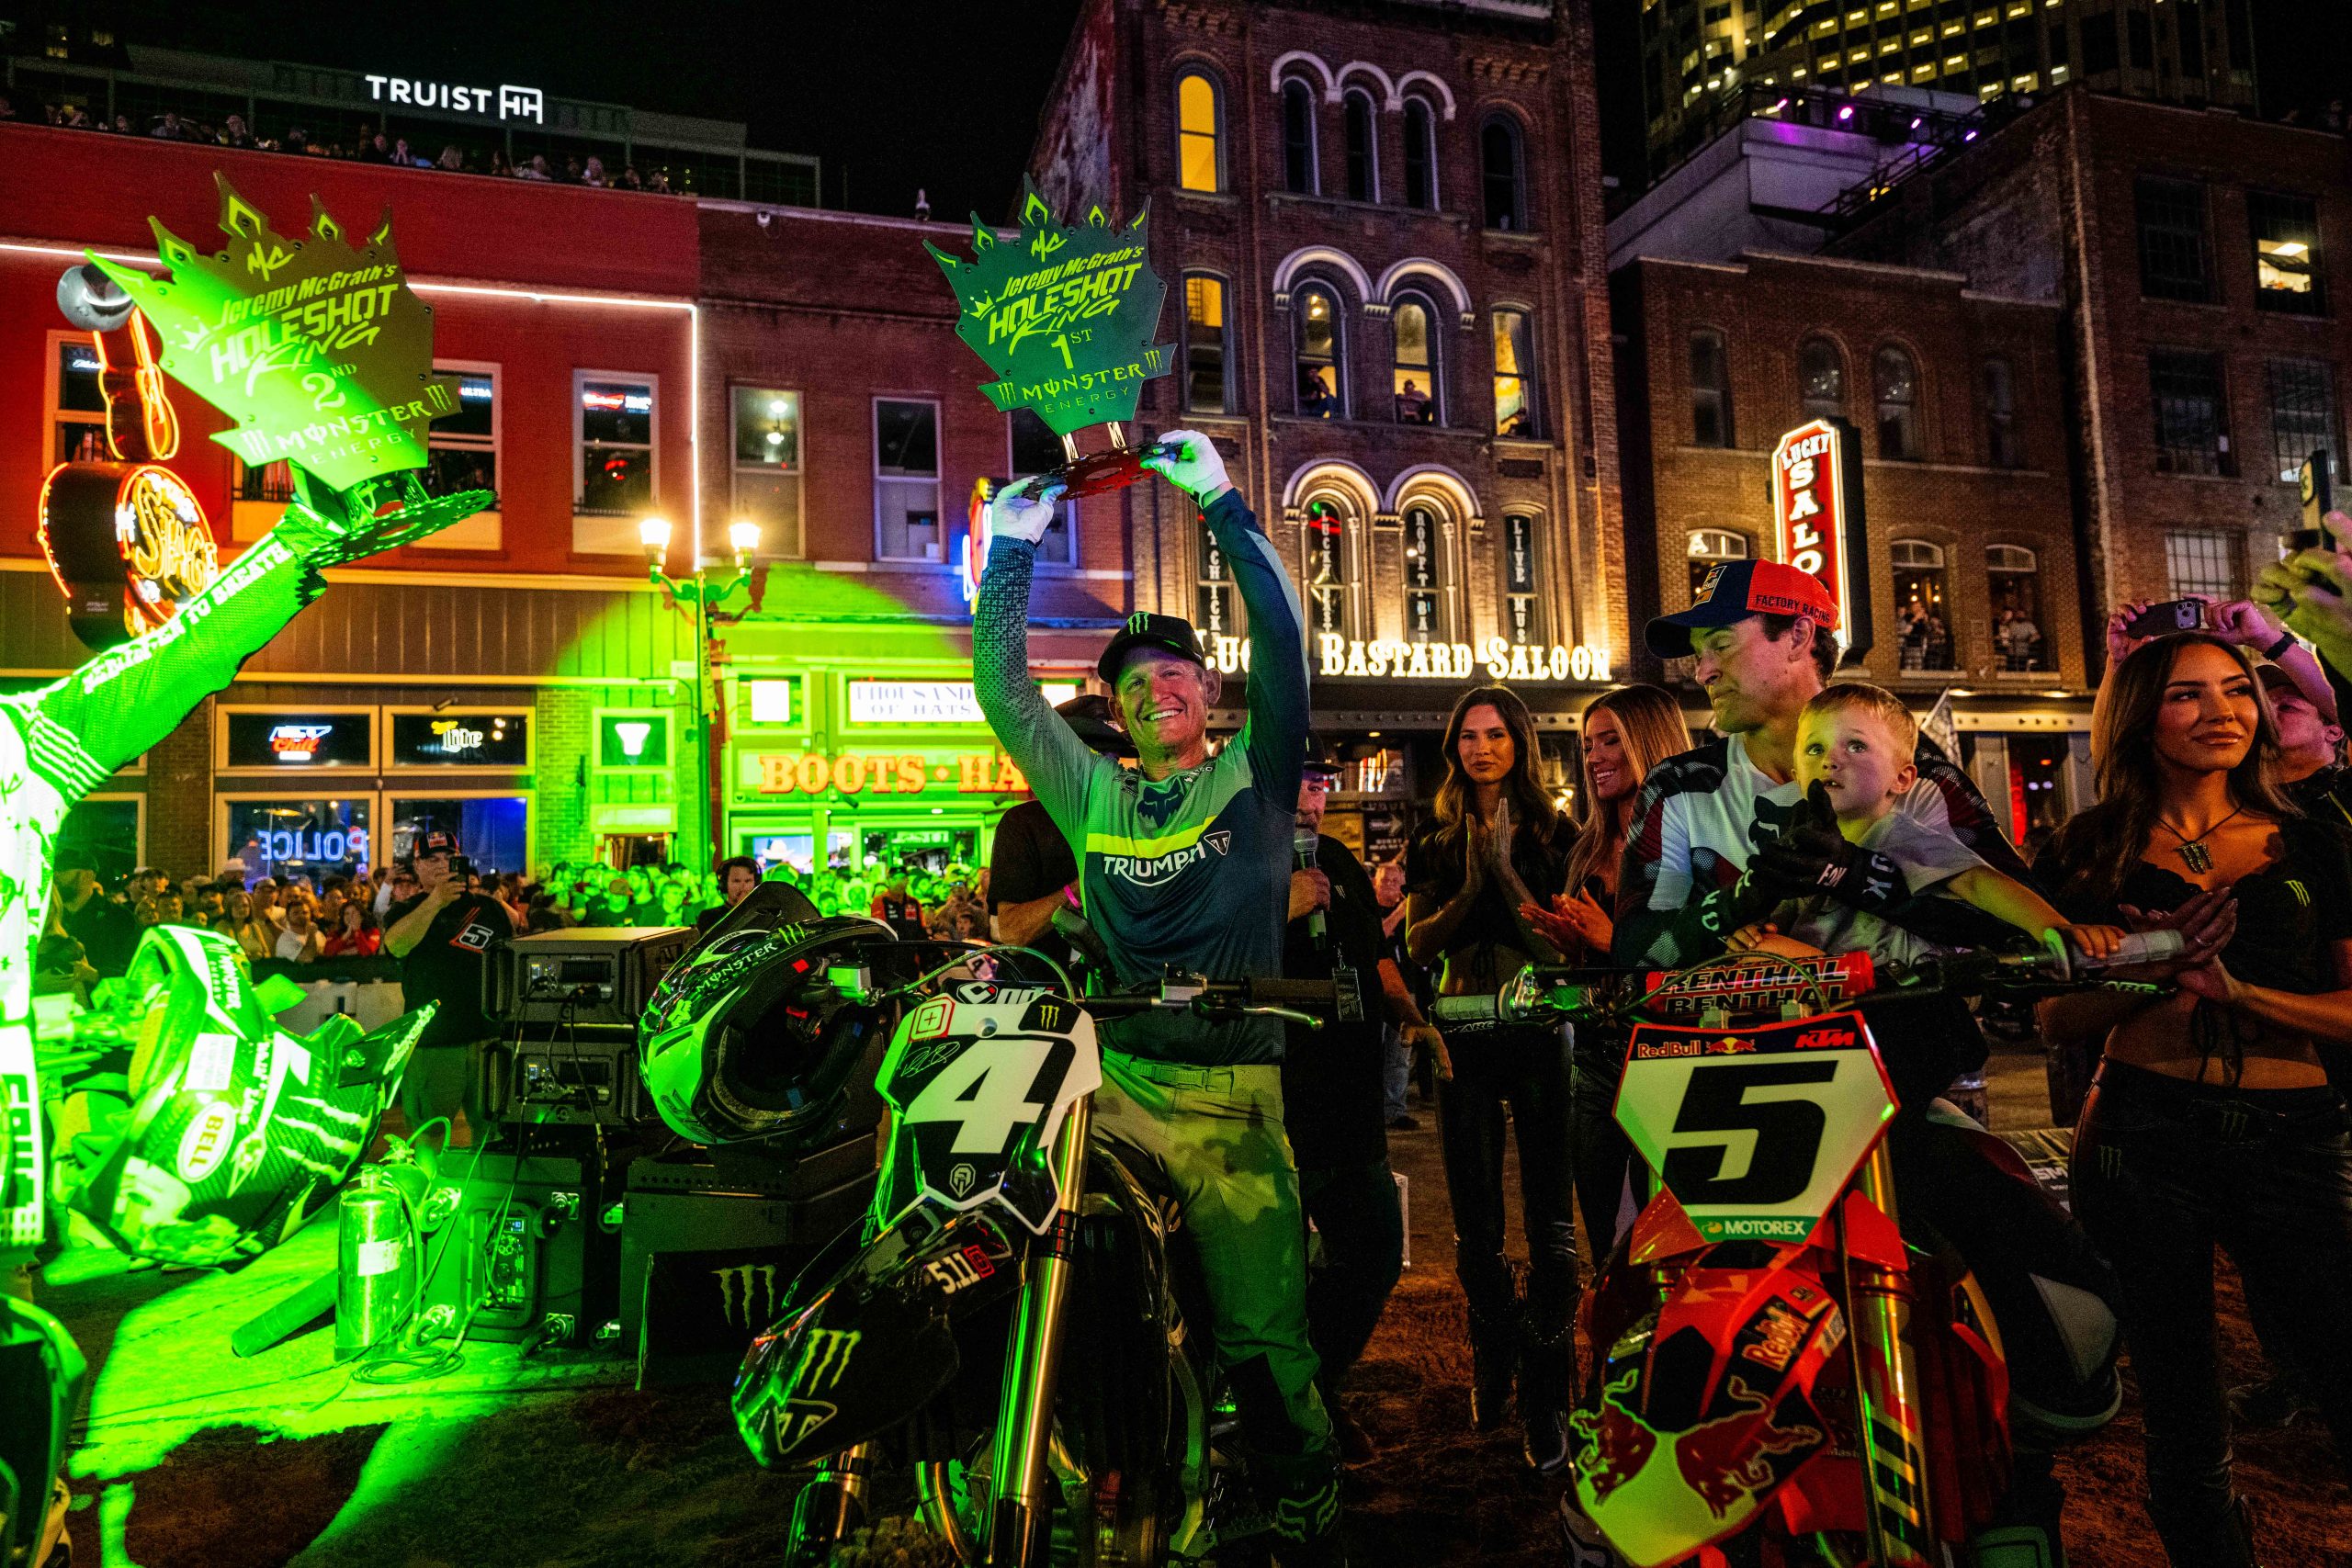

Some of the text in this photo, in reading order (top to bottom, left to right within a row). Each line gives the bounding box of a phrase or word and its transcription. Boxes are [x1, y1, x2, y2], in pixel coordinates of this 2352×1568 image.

[365, 74, 493, 113] TRUIST
[212, 264, 398, 331] Jeremy McGrath's
[996, 245, 1145, 303] Jeremy McGrath's
[988, 263, 1143, 345] HOLESHOT
[209, 284, 399, 384] HOLESHOT
[1022, 362, 1147, 402] MONSTER
[1045, 386, 1129, 414] ENERGY
[276, 400, 433, 452] MONSTER
[311, 428, 416, 464] ENERGY
[1779, 433, 1830, 470] LUCKY
[1788, 457, 1824, 575] SALO
[210, 541, 294, 606] BREATH
[1513, 519, 1527, 644] LIVE MUS
[1756, 595, 1831, 624] FACTORY RACING
[1318, 632, 1474, 679] BASTARD
[1486, 636, 1612, 682] SALOON
[856, 685, 972, 700] THOUSAND
[758, 754, 1031, 795] BOOTS HA
[695, 942, 778, 993] MONSTER
[1659, 958, 1849, 995] RENTHAL
[1795, 1029, 1855, 1048] KTM
[902, 1039, 1055, 1154] 4
[187, 1113, 224, 1168] BELL
[1661, 1059, 1839, 1205] 5
[1724, 1220, 1806, 1236] MOTOREX
